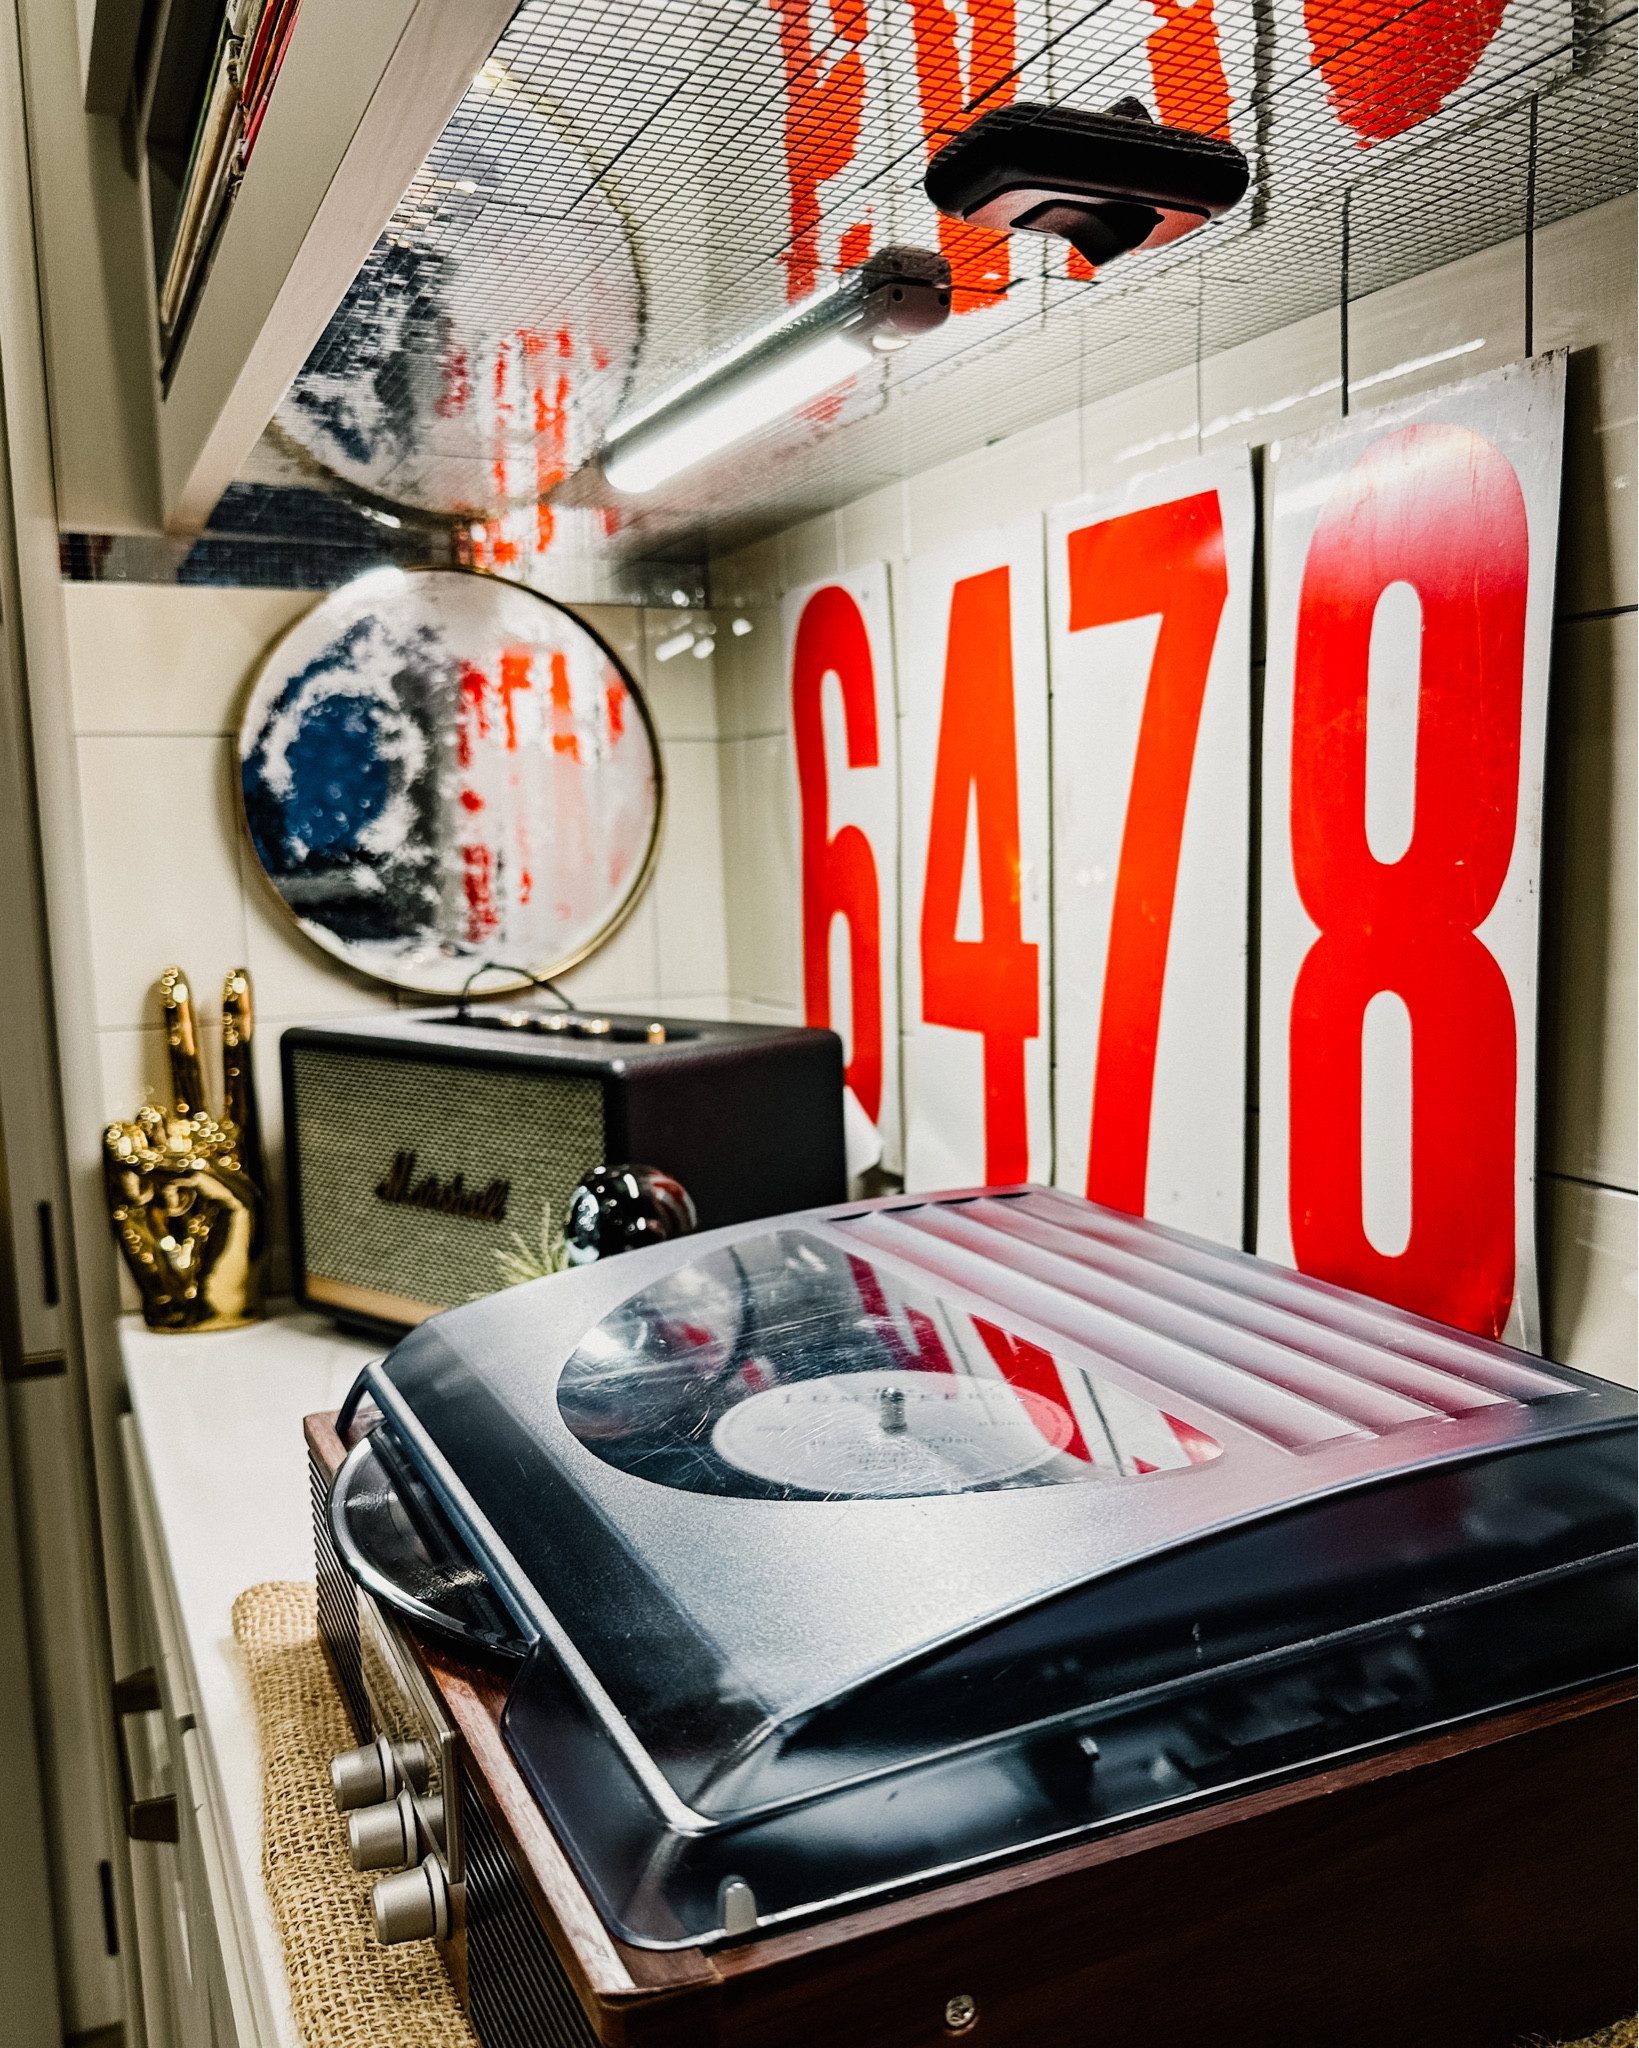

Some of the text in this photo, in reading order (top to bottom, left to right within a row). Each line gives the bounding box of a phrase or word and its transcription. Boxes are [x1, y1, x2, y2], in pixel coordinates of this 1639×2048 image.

[921, 565, 1039, 1187] 4
[1068, 490, 1228, 1218] 7
[1290, 423, 1529, 1342] 8
